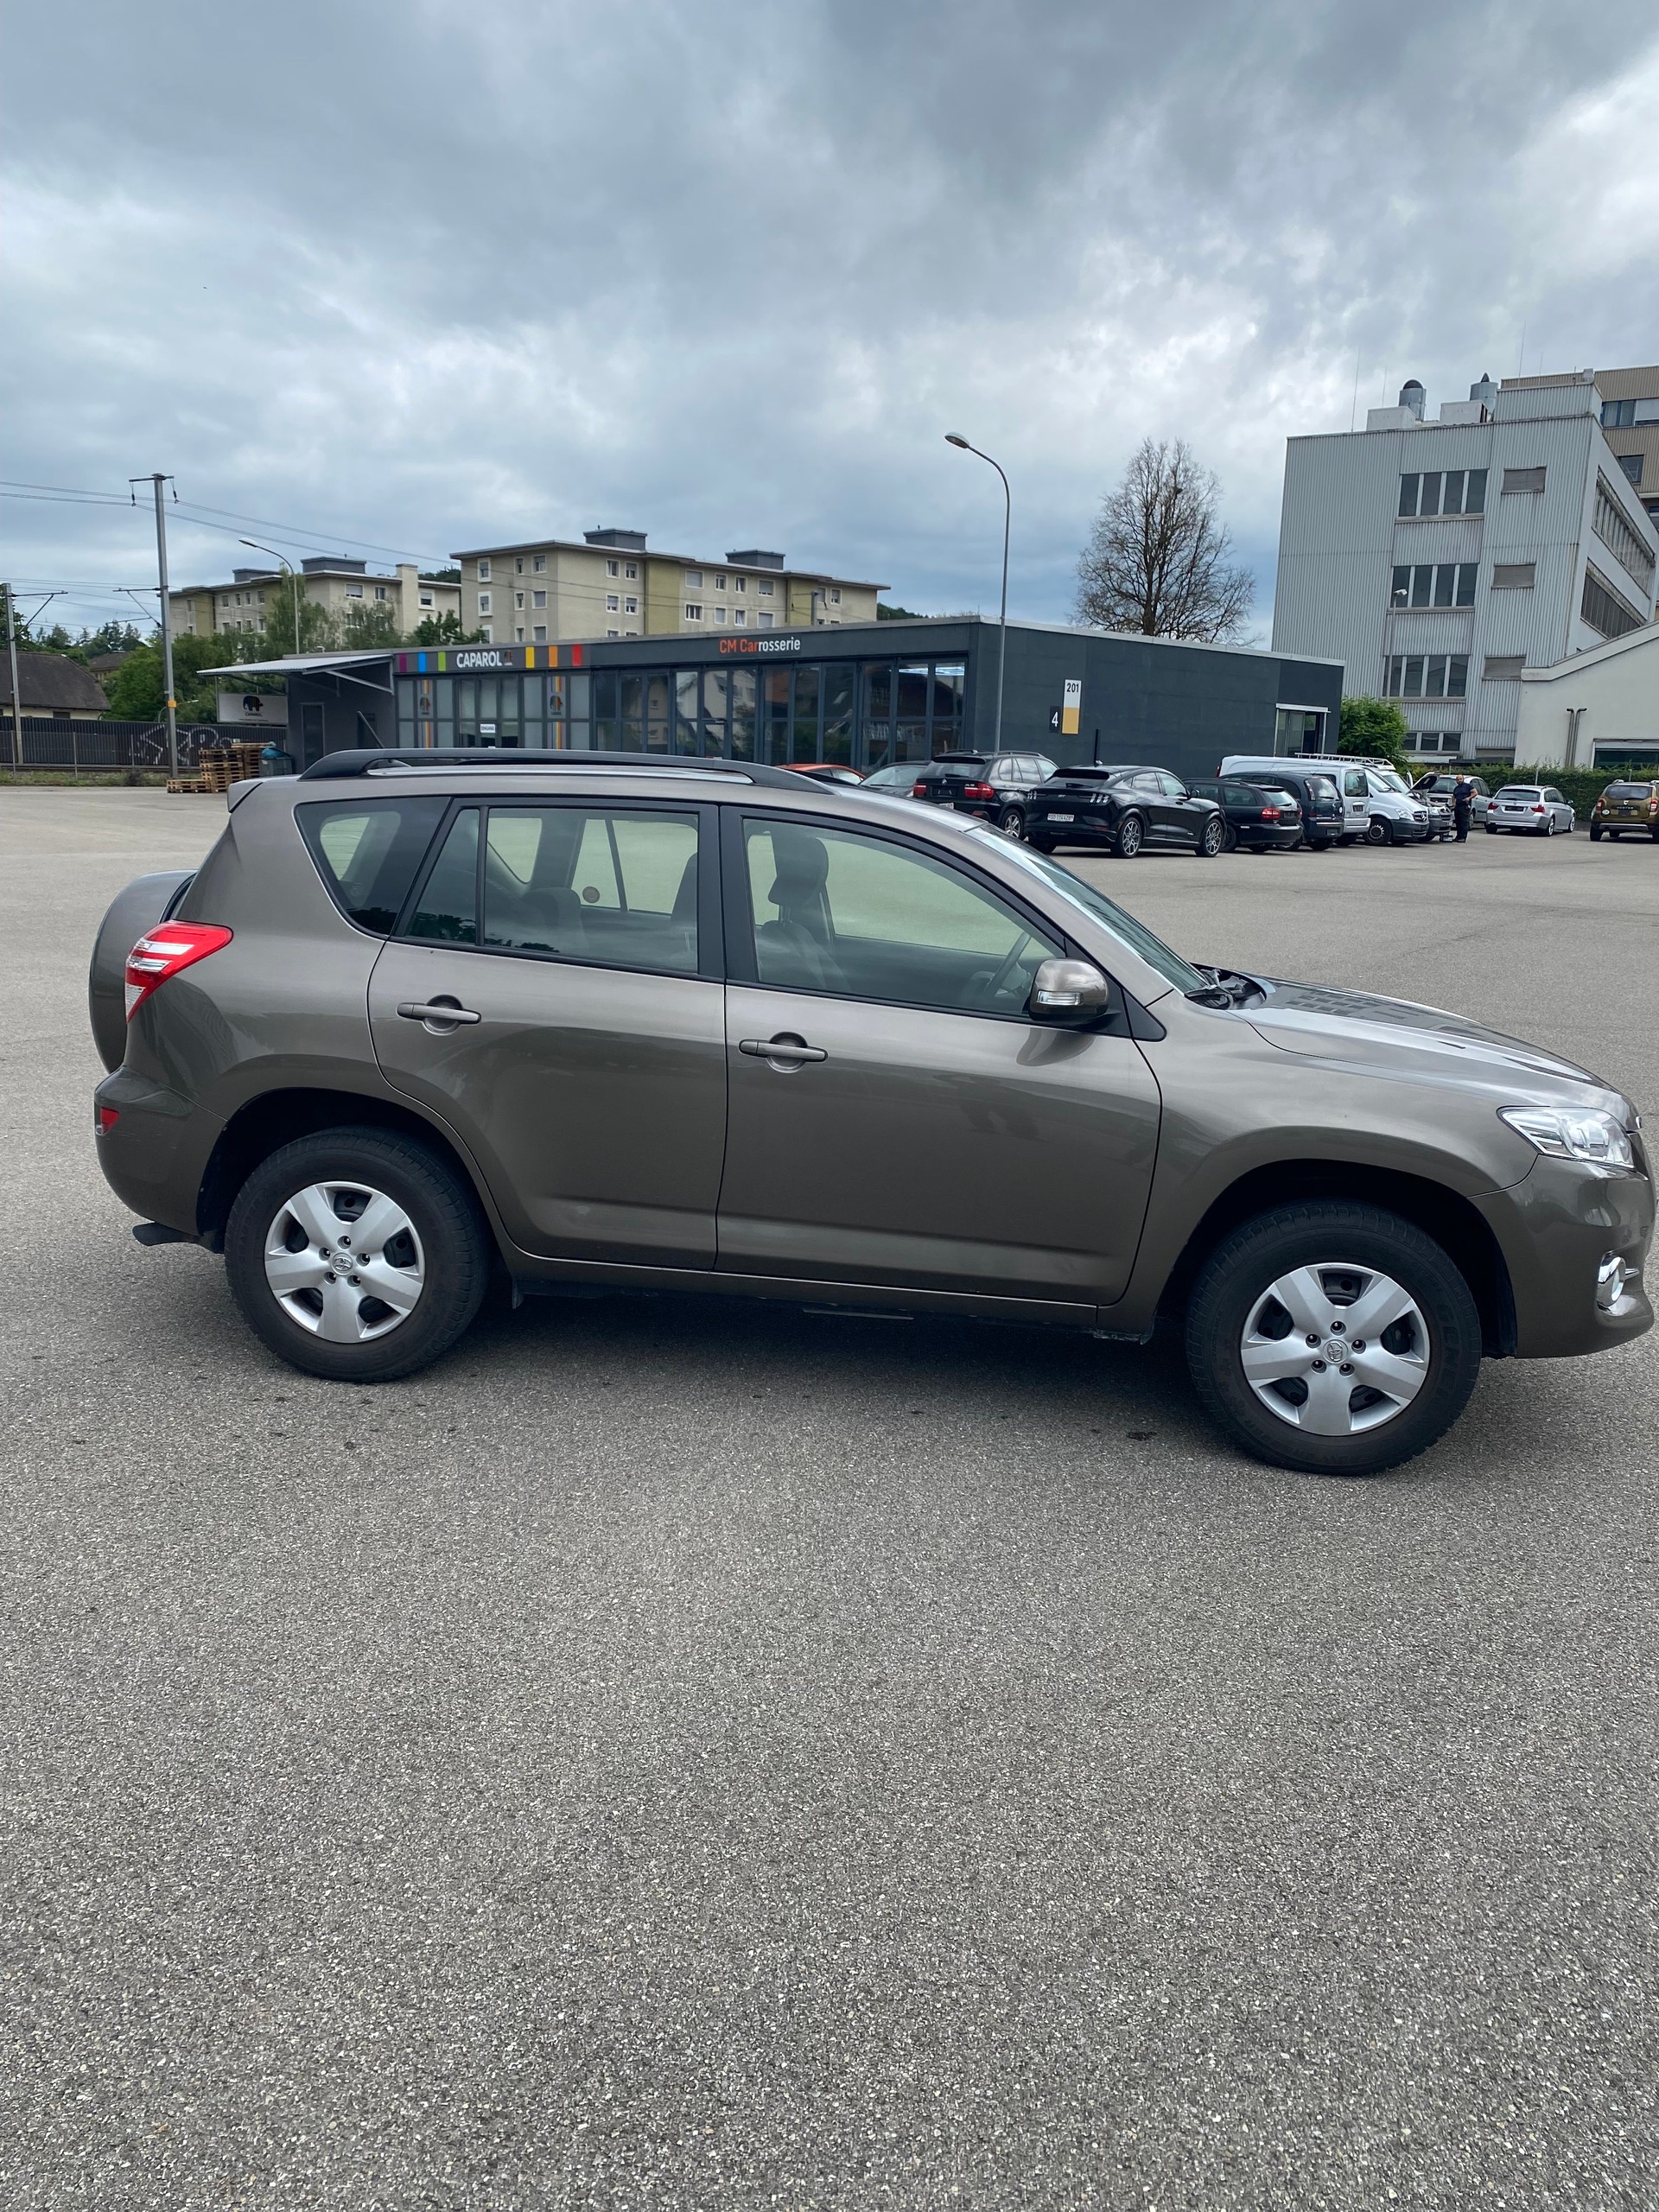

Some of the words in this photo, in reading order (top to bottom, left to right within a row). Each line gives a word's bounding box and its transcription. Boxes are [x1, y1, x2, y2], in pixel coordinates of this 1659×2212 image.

[719, 639, 737, 653] CM
[740, 636, 800, 652] Carrosserie
[456, 651, 502, 668] CAPAROL
[1066, 683, 1079, 693] 201
[1051, 711, 1058, 728] 4
